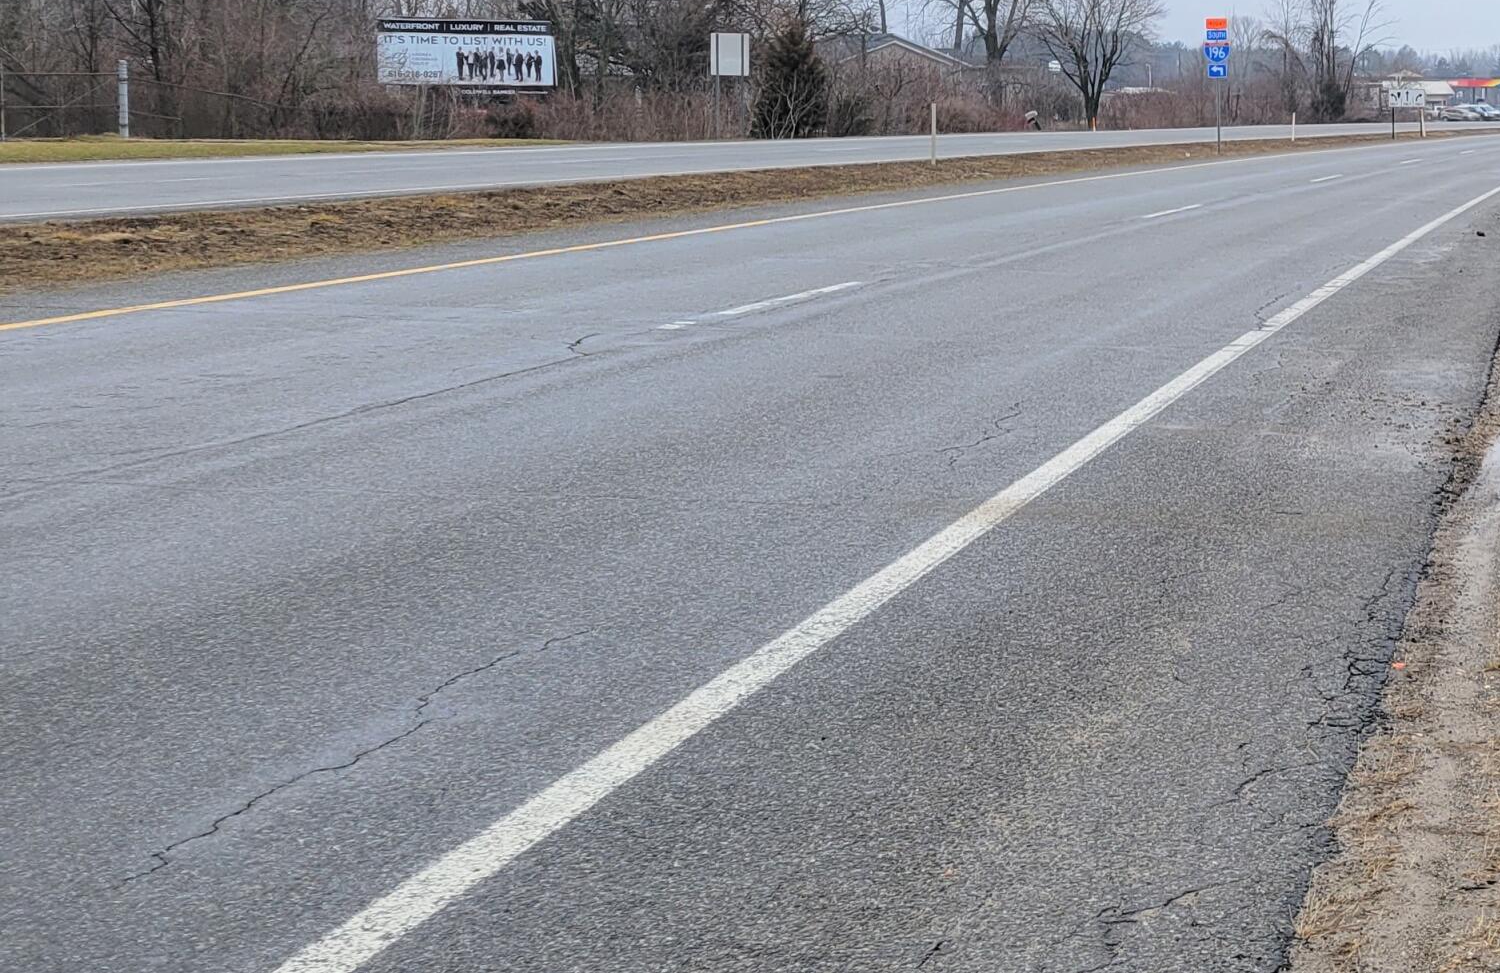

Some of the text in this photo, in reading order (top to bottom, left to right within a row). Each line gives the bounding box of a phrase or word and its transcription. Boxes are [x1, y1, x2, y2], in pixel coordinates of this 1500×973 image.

[383, 22, 440, 30] WATERFRONT
[450, 23, 484, 31] LUXURY
[494, 24, 516, 32] REAL
[384, 35, 547, 46] IT'S TIME TO LIST WITH US!
[1209, 46, 1226, 58] 196
